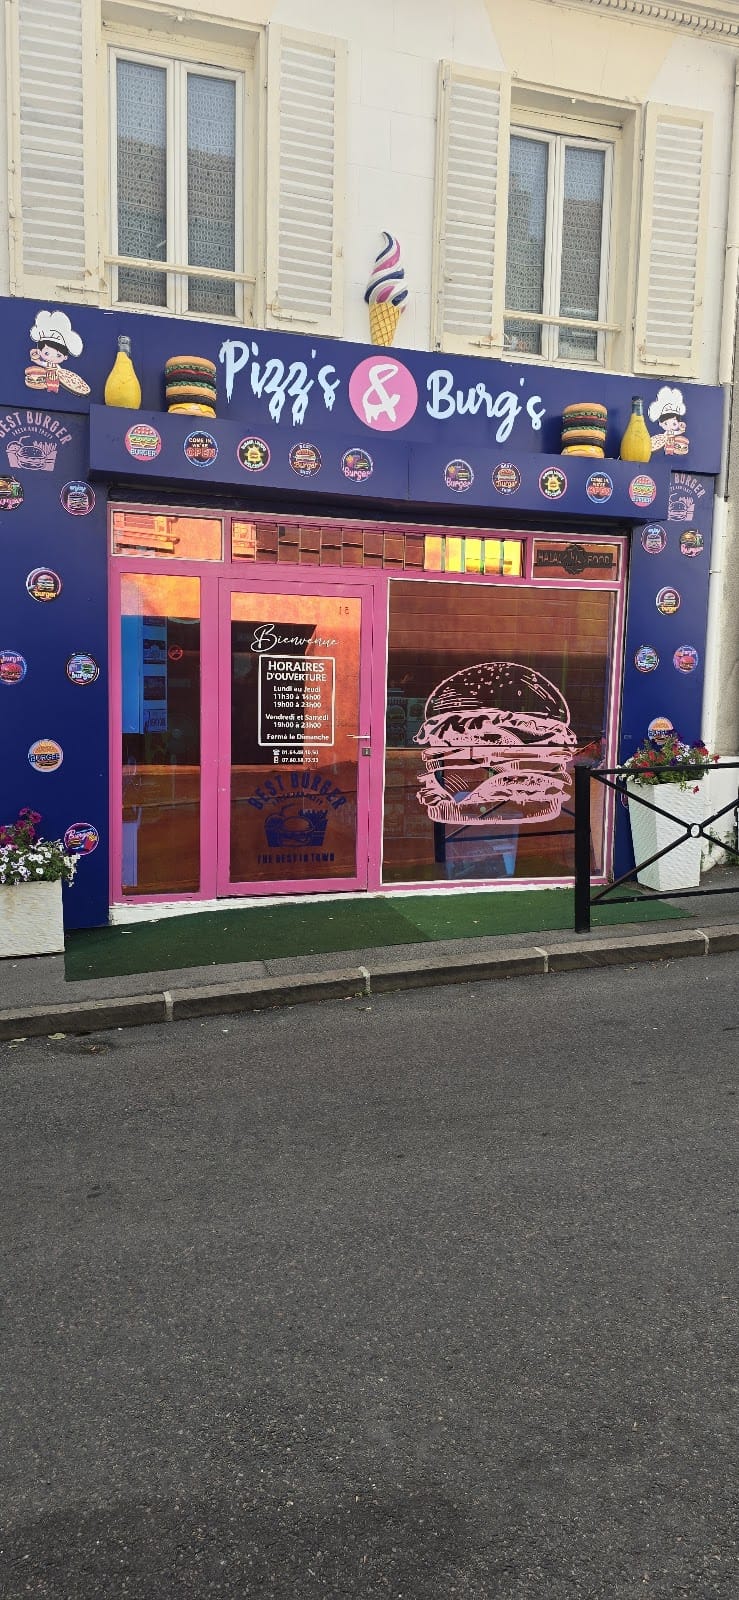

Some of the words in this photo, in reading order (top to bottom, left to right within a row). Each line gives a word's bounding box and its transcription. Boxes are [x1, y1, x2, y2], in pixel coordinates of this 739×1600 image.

[219, 339, 340, 427] Pizz's
[363, 363, 400, 424] &
[426, 369, 546, 443] Burg's
[26, 411, 72, 444] BURGER
[130, 448, 157, 457] BURGER
[186, 447, 216, 458] OPEN
[293, 460, 318, 471] Burger
[344, 466, 372, 480] Burger
[446, 477, 472, 491] Burger
[674, 472, 705, 499] BURGER
[0, 498, 23, 510] urger
[250, 623, 338, 652] Bienvenue
[268, 660, 325, 672] HORAIRES
[266, 672, 327, 682] D'OUVERTURE
[29, 753, 61, 763] BURGER
[248, 774, 284, 810] BEST
[290, 772, 347, 810] BURGER
[67, 829, 94, 841] Burger
